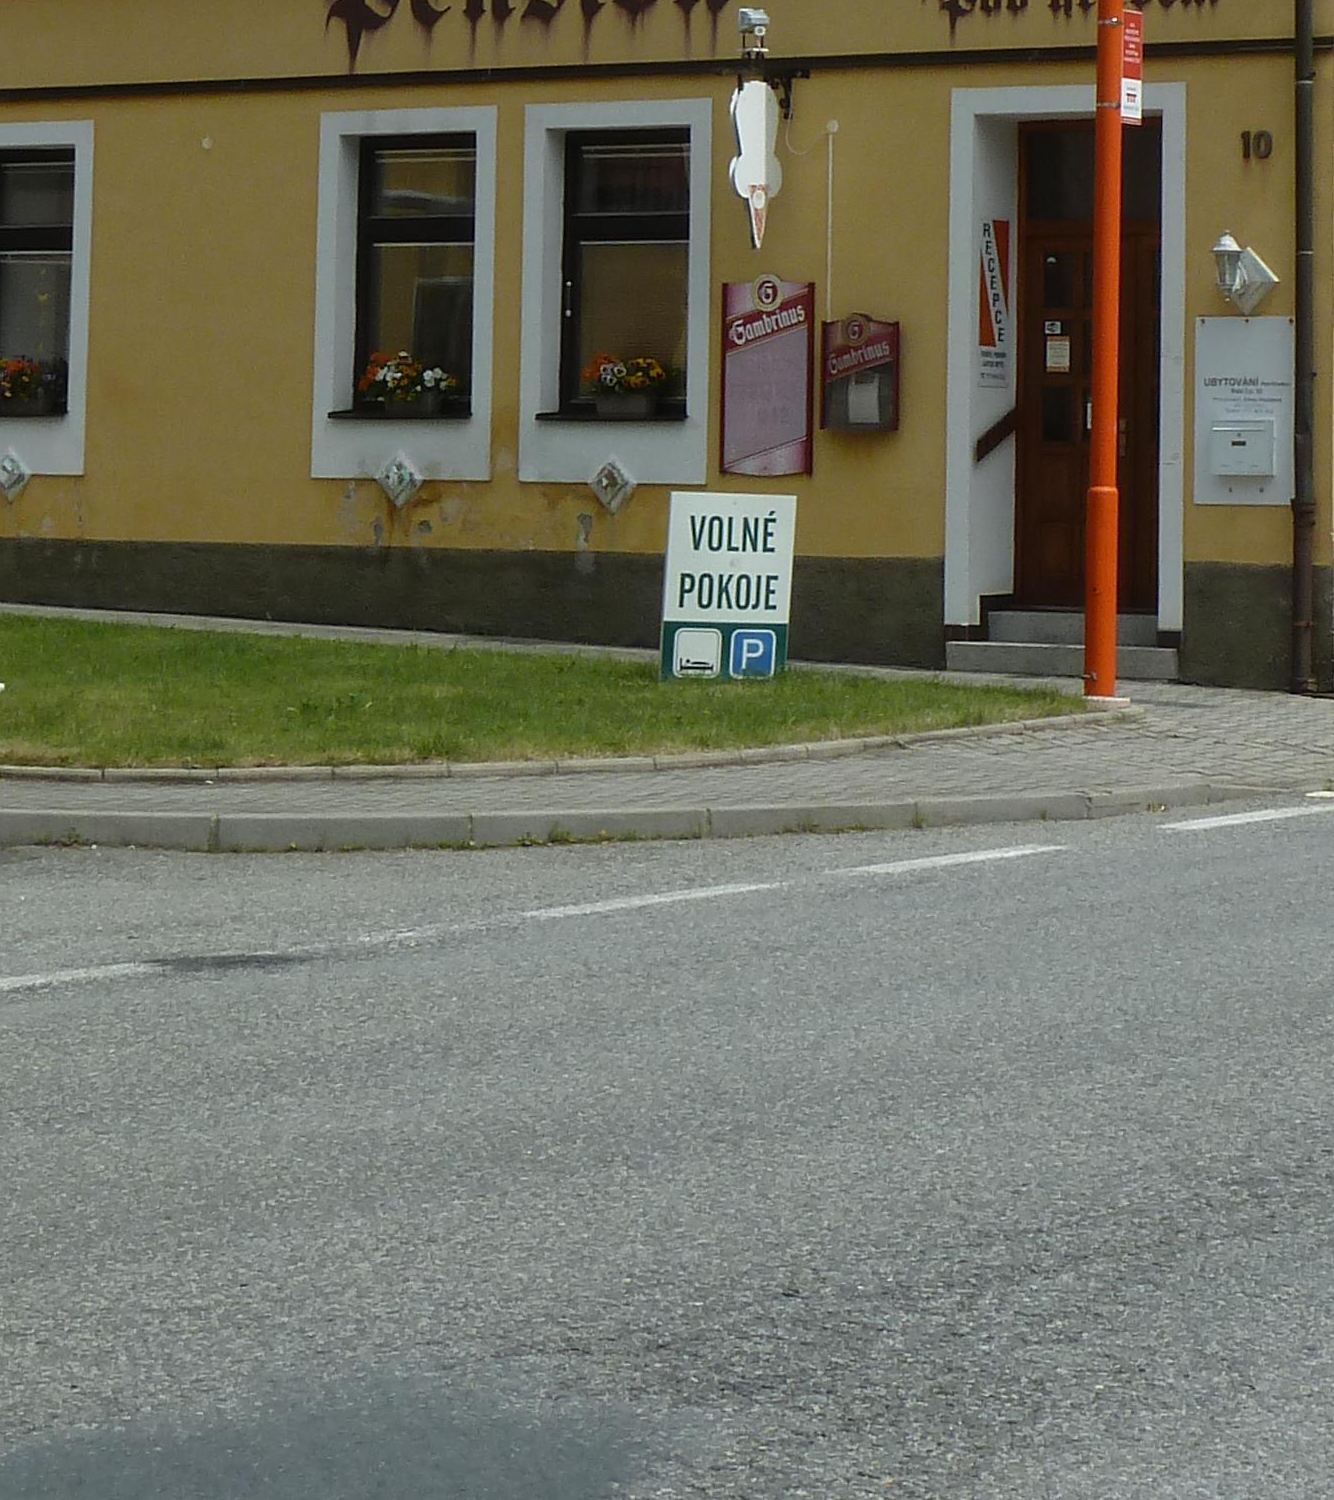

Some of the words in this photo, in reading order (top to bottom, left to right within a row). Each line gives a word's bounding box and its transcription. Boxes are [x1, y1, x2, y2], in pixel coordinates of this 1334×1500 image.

[1240, 130, 1273, 160] 10
[982, 222, 1005, 343] RECEPCE
[729, 304, 806, 346] Gambrinus
[827, 340, 891, 375] Gambrinus
[689, 510, 777, 553] VOLNÉ
[678, 572, 779, 610] POKOJE
[741, 638, 764, 670] P
